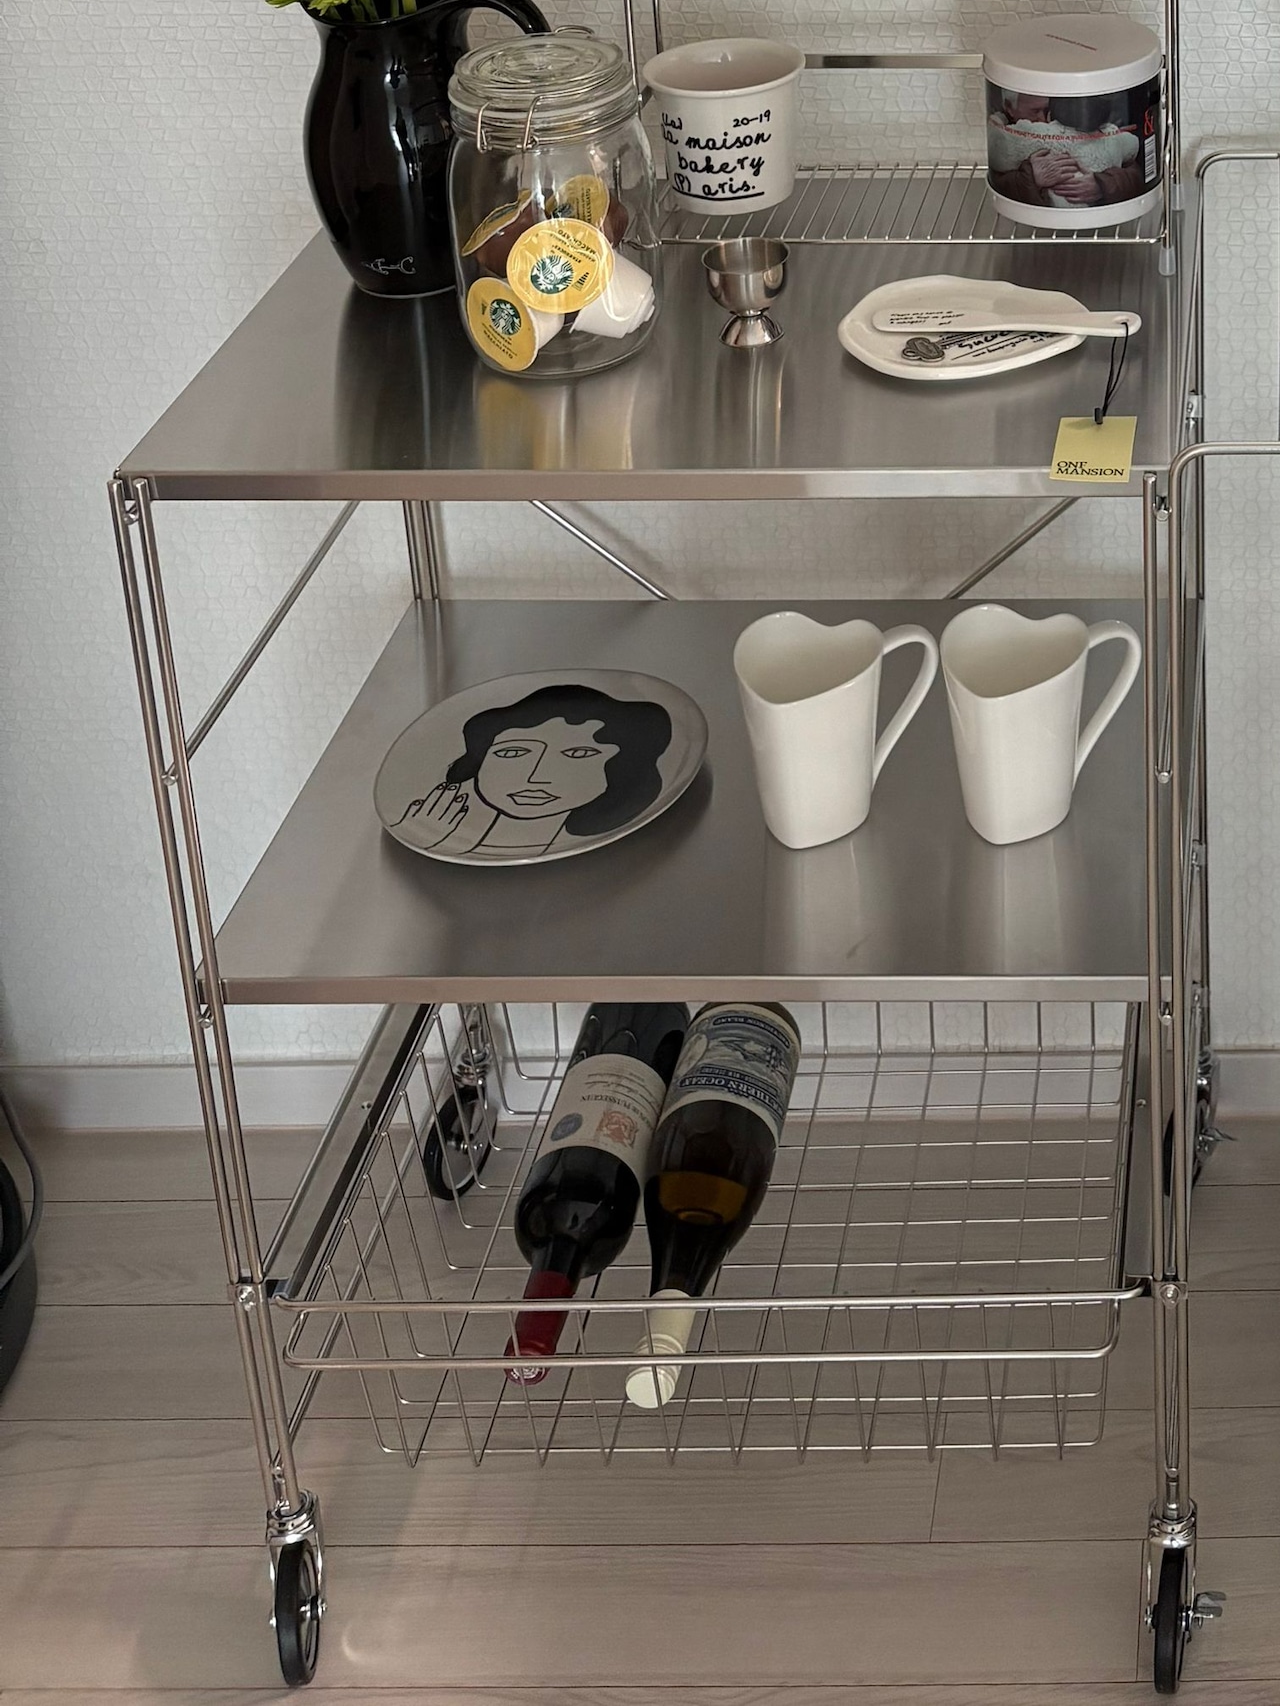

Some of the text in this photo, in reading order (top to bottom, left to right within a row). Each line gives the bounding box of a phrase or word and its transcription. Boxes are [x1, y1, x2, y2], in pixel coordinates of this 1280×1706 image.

[685, 131, 771, 150] maison
[677, 151, 765, 177] bakery
[1055, 468, 1125, 477] MANSION
